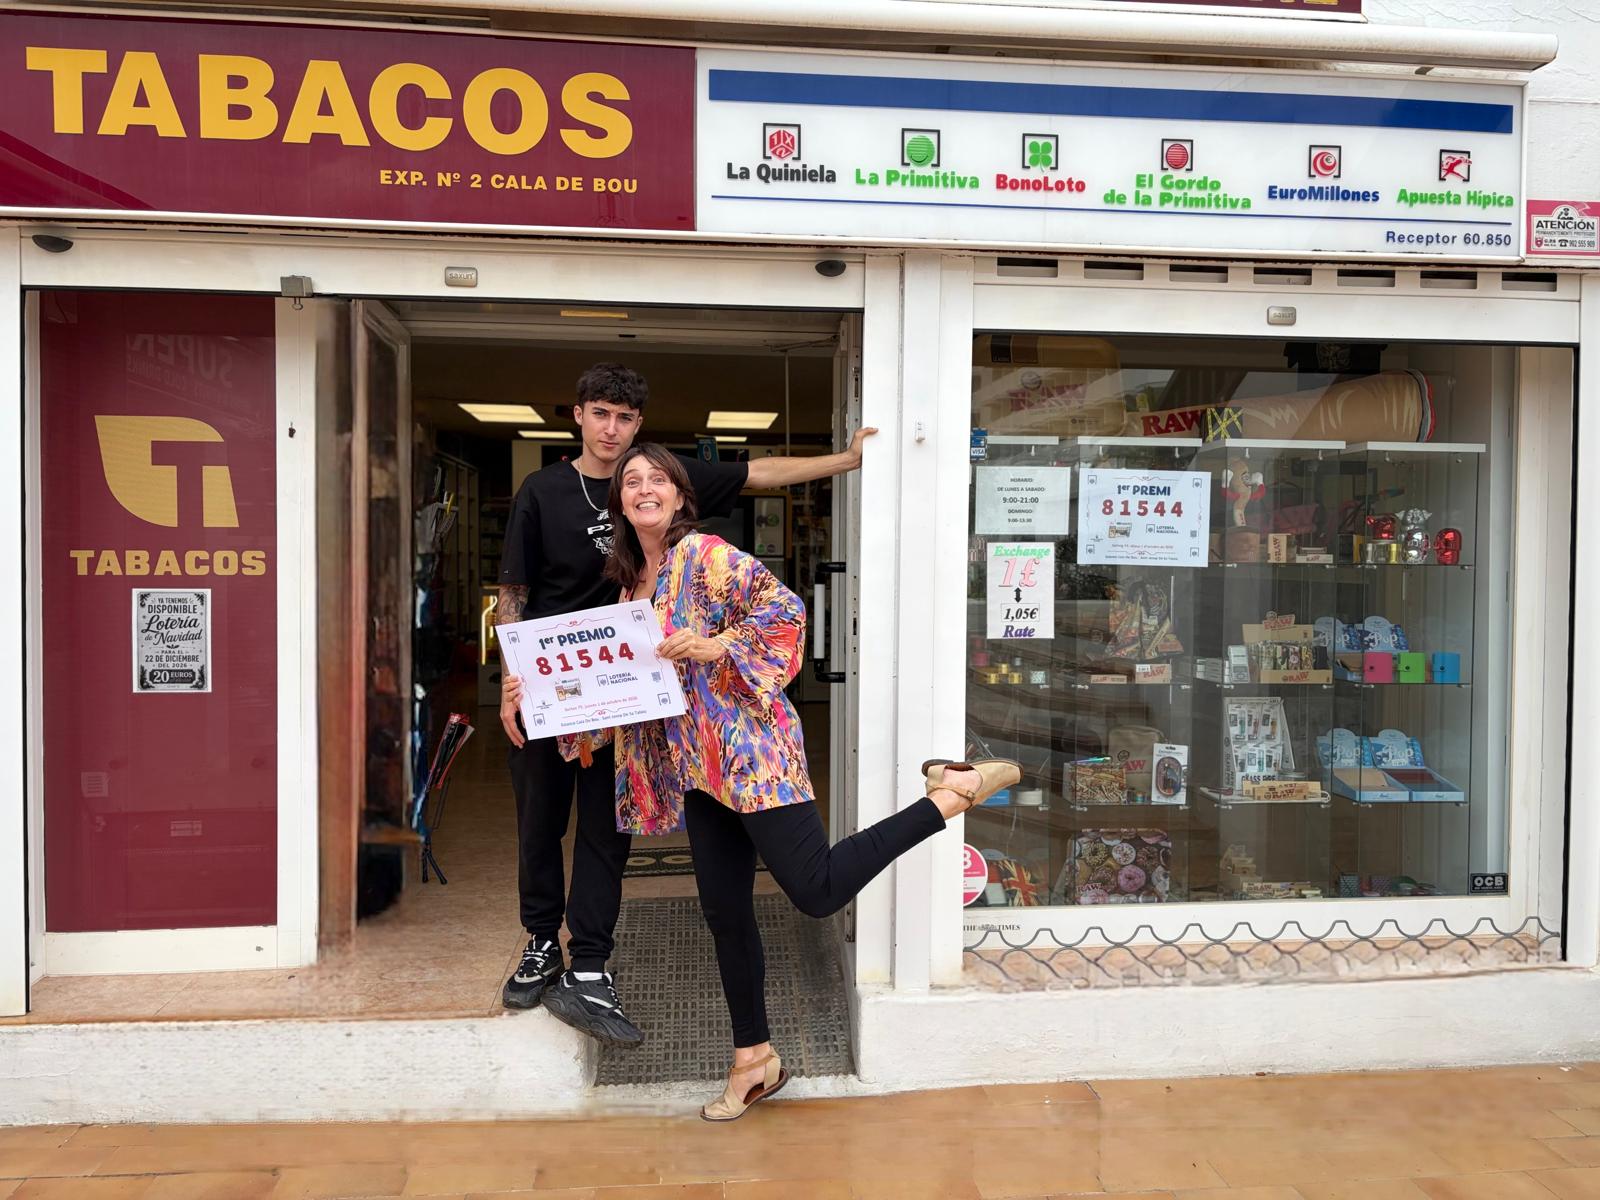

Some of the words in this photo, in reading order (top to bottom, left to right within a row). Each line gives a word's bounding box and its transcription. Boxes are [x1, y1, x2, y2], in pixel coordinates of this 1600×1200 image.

[26, 46, 634, 158] TABACOS
[380, 169, 427, 188] EXP.
[470, 173, 481, 189] 2
[490, 174, 548, 191] CALA
[556, 176, 584, 192] DE
[592, 177, 638, 193] BOU
[727, 162, 750, 180] La
[757, 163, 837, 183] Quiniela
[855, 169, 879, 187] La
[886, 169, 980, 189] Primitiva
[995, 174, 1086, 193] BonoLoto
[1135, 174, 1154, 189] El
[1160, 174, 1221, 191] Gordo
[1103, 188, 1127, 205] de
[1134, 189, 1152, 206] la
[1159, 190, 1252, 209] Primitiva
[1267, 185, 1380, 203] EuroMillones
[1397, 188, 1462, 207] Apuesta
[1466, 189, 1514, 208] Hípica
[1536, 219, 1595, 230] ATENCIÓN
[1386, 230, 1458, 247] Receptor
[1463, 232, 1512, 247] 60.850
[1141, 409, 1201, 436] RAW
[1117, 485, 1130, 495] 1er
[1133, 485, 1171, 496] PREMI
[1102, 499, 1183, 518] 81544
[993, 546, 1051, 558] Exchange
[70, 550, 266, 576] TABACOS
[147, 604, 198, 614] DISPONIBLE
[1004, 607, 1038, 622] 1,05€
[141, 615, 200, 633] Lotería
[1003, 625, 1035, 638] Rate
[153, 629, 203, 645] Navidad
[539, 635, 554, 650] 1er
[557, 626, 616, 647] PREMIO
[536, 642, 635, 676] 81544
[153, 671, 169, 683] 20
[610, 676, 638, 684] NACIONAL
[1474, 876, 1504, 887] OCB
